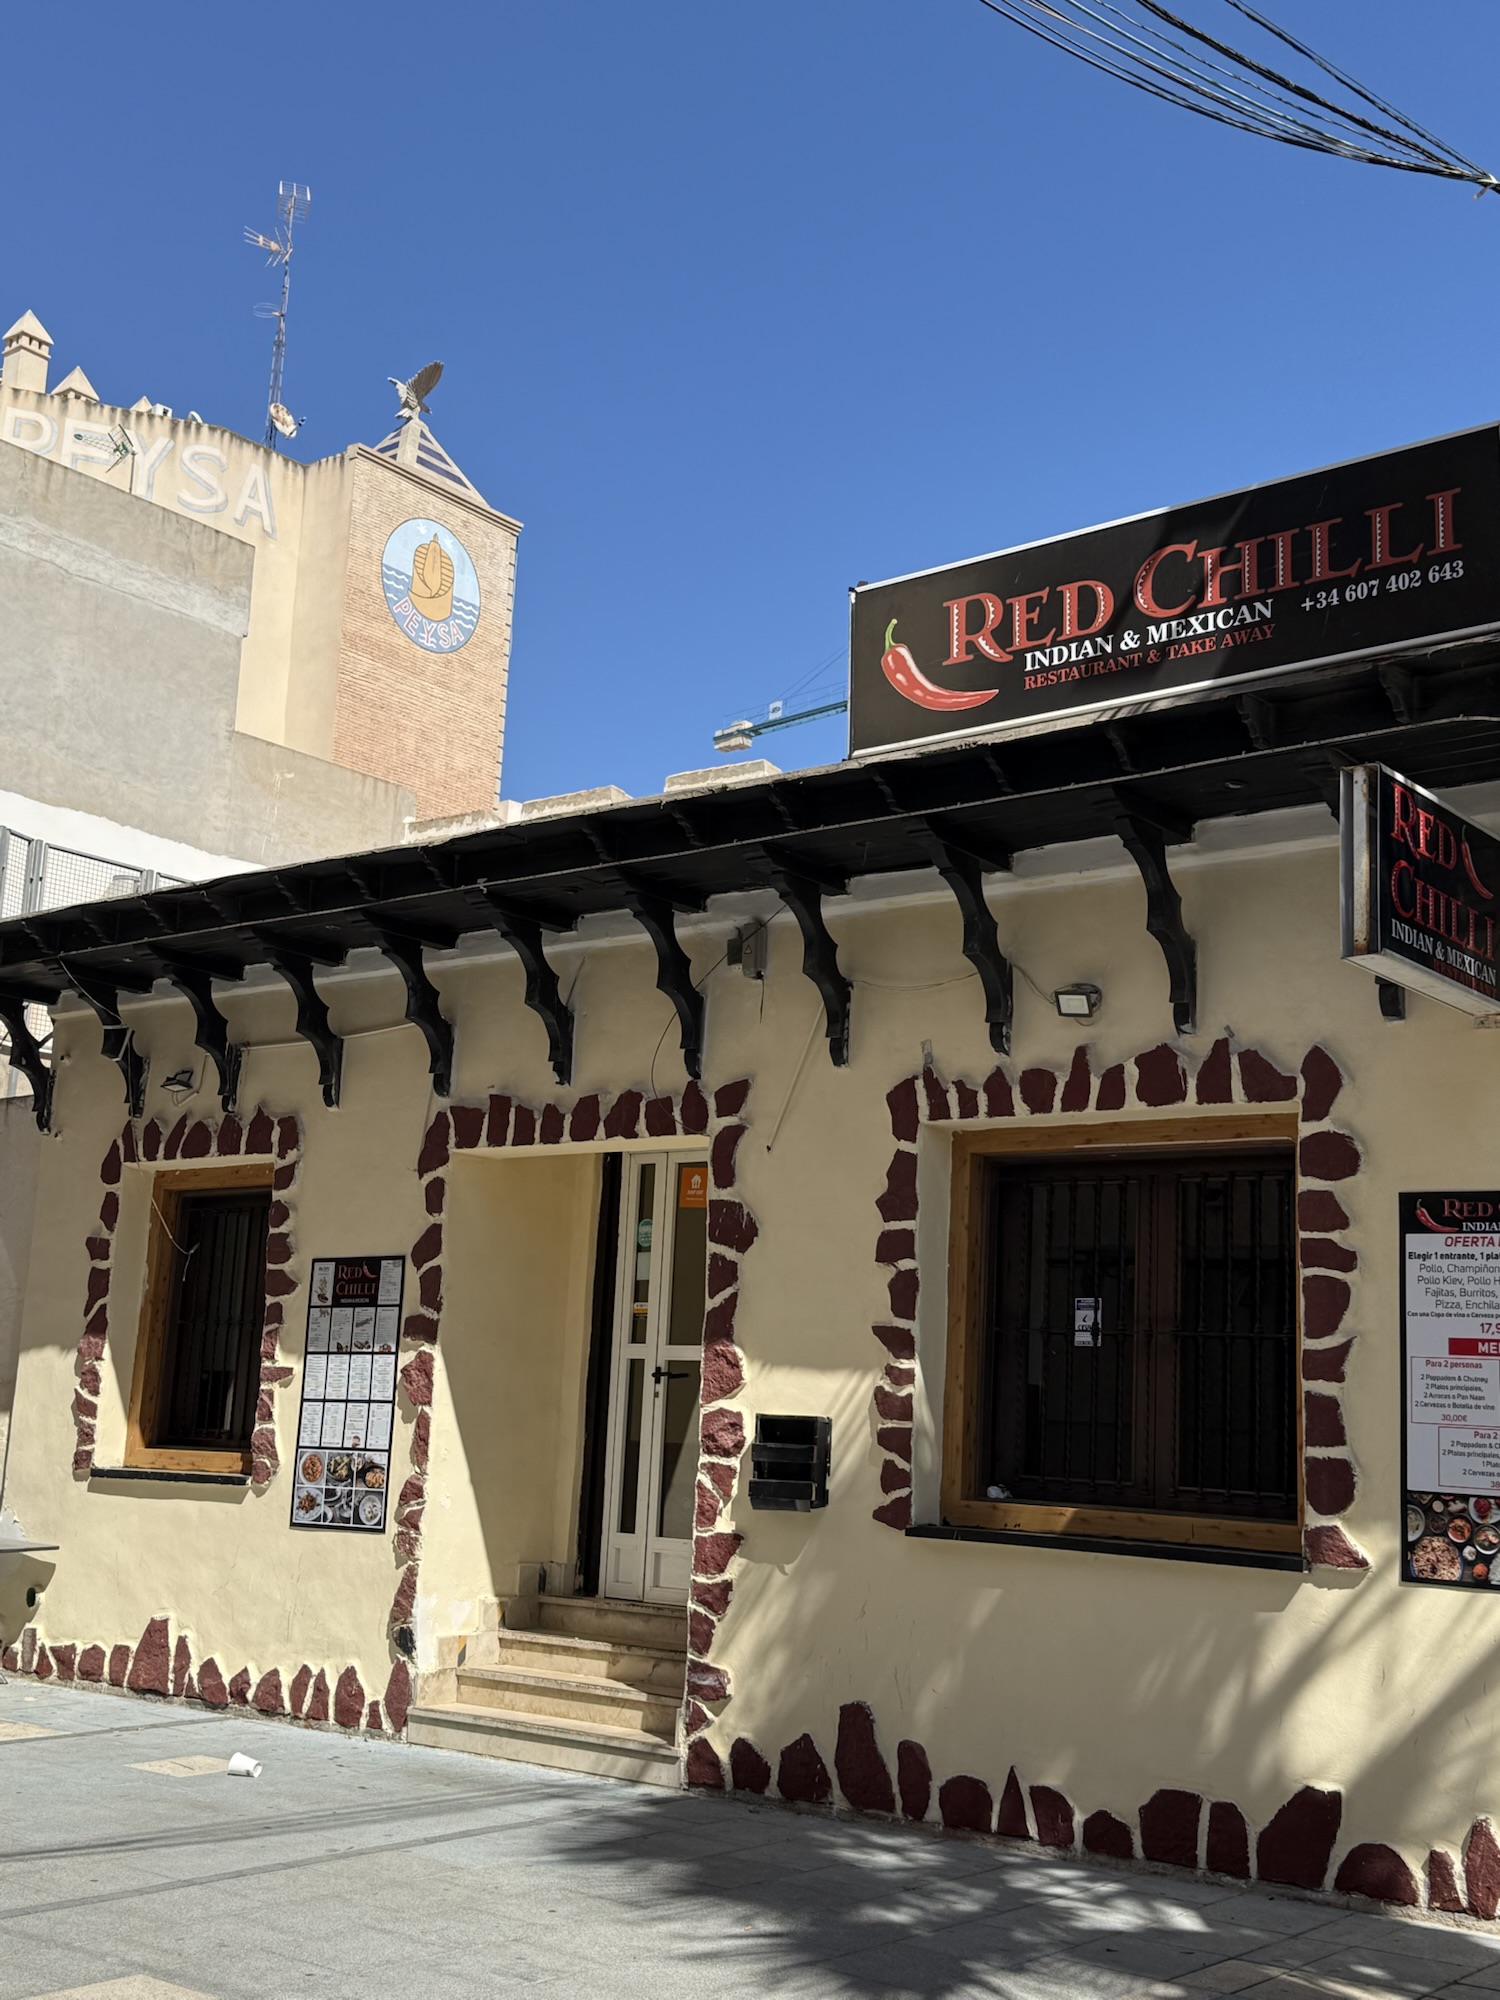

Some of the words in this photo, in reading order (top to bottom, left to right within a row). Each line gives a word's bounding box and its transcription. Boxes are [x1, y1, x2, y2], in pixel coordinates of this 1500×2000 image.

[942, 580, 1114, 666] RED
[1133, 487, 1463, 618] CHILLI
[1300, 589, 1340, 612] +34
[1345, 579, 1380, 603] 607
[1385, 570, 1422, 593] 402
[1428, 560, 1464, 583] 643
[393, 596, 465, 649] PEYSA
[1024, 634, 1114, 672] INDIAN
[1119, 630, 1141, 651] &
[1146, 598, 1274, 646] MEXICAN
[1023, 653, 1143, 691] RESTAURANT
[1146, 649, 1161, 664] &
[1165, 636, 1217, 661] TAKE
[1220, 623, 1277, 648] AWAY
[1391, 782, 1457, 869] RED
[1391, 860, 1495, 962] CHILLI
[1391, 918, 1434, 956] INDIAN
[1435, 941, 1446, 962] &
[1446, 946, 1497, 987] MEXICAN
[1442, 1199, 1494, 1219] RED
[1462, 1222, 1500, 1231] INDIA
[1444, 1236, 1495, 1247] OFERTA
[1408, 1251, 1432, 1262] Elegir
[1434, 1252, 1439, 1260] 1
[1440, 1252, 1477, 1261] entrante,
[1480, 1252, 1484, 1260] 1
[1486, 1252, 1500, 1262] pla
[338, 1265, 363, 1280] RED
[1419, 1263, 1444, 1274] Pollo,
[1417, 1275, 1440, 1285] Pollo
[1442, 1276, 1464, 1286] Kiev,
[1467, 1276, 1491, 1286] Pollo
[336, 1281, 376, 1296] CHILLI
[1425, 1287, 1456, 1299] Fajitas,
[1459, 1288, 1498, 1299] Burritos,
[1435, 1299, 1462, 1310] Pizza,
[1478, 1342, 1500, 1354] ME
[1425, 1359, 1442, 1368] Para
[1443, 1360, 1449, 1368] 2
[1450, 1361, 1483, 1370] personas
[1463, 1375, 1489, 1384] Chutney
[1430, 1383, 1449, 1391] Platos
[1450, 1384, 1484, 1393] principales,
[1428, 1392, 1450, 1400] Arroces
[1414, 1400, 1420, 1408] 2
[1420, 1401, 1446, 1409] Cervezas
[1441, 1413, 1468, 1422] 30,00€
[1473, 1431, 1491, 1440] Para
[1492, 1432, 1498, 1440] 2
[1450, 1440, 1455, 1448] 2
[1455, 1440, 1487, 1449] Poppadom
[1447, 1449, 1466, 1457] Platos
[1467, 1469, 1495, 1477] Cervezas
